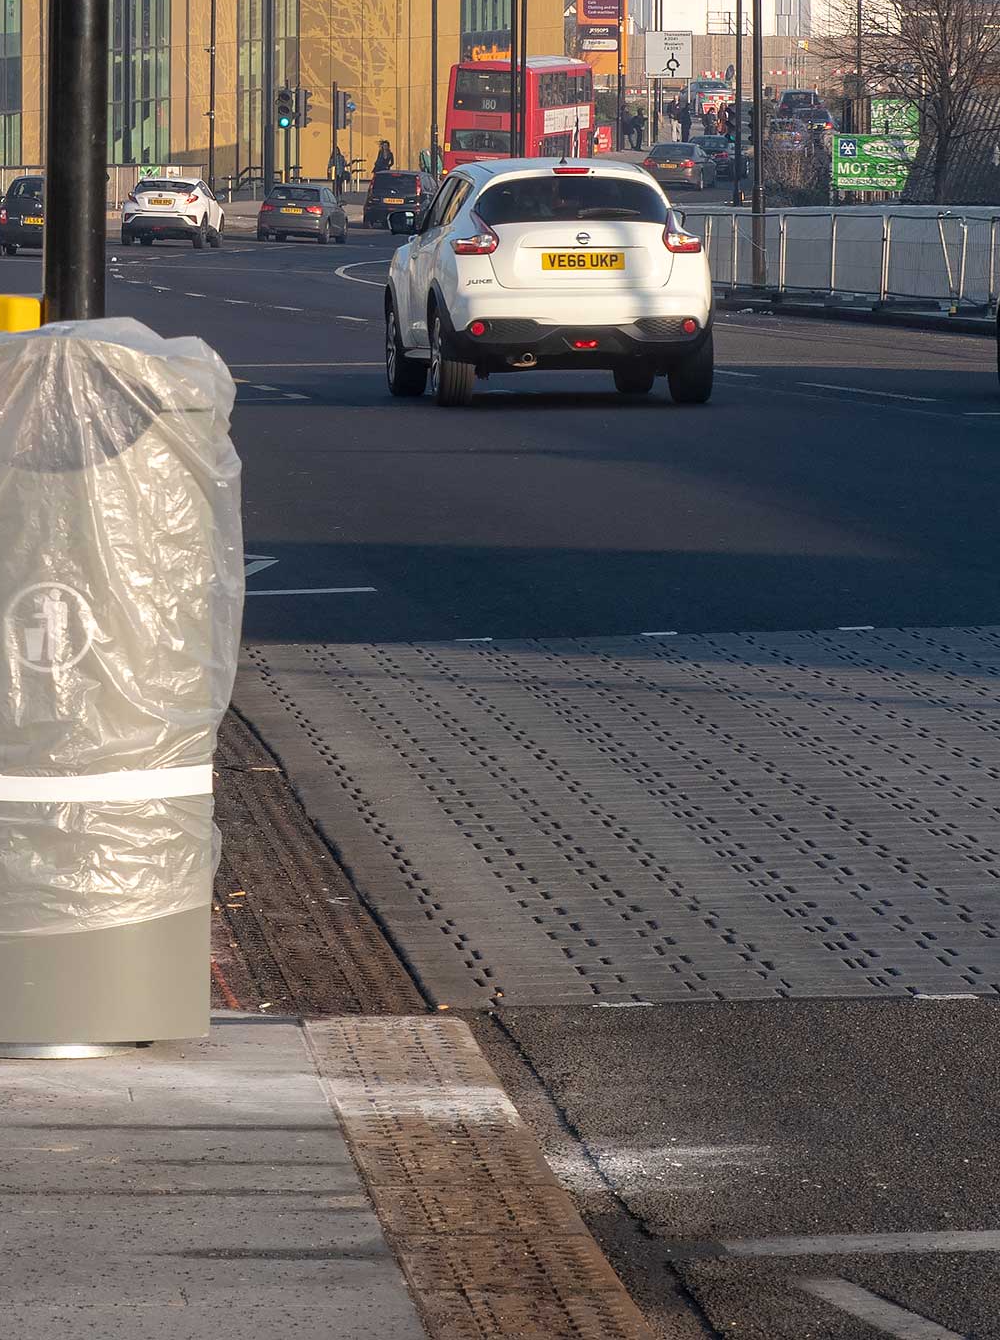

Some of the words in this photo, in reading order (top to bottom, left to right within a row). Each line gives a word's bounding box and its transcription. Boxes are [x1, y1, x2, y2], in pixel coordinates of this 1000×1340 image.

[482, 99, 496, 110] 180
[838, 162, 870, 174] MOT
[548, 254, 586, 267] VE66
[590, 254, 619, 267] UKP
[466, 278, 493, 286] JUKE
